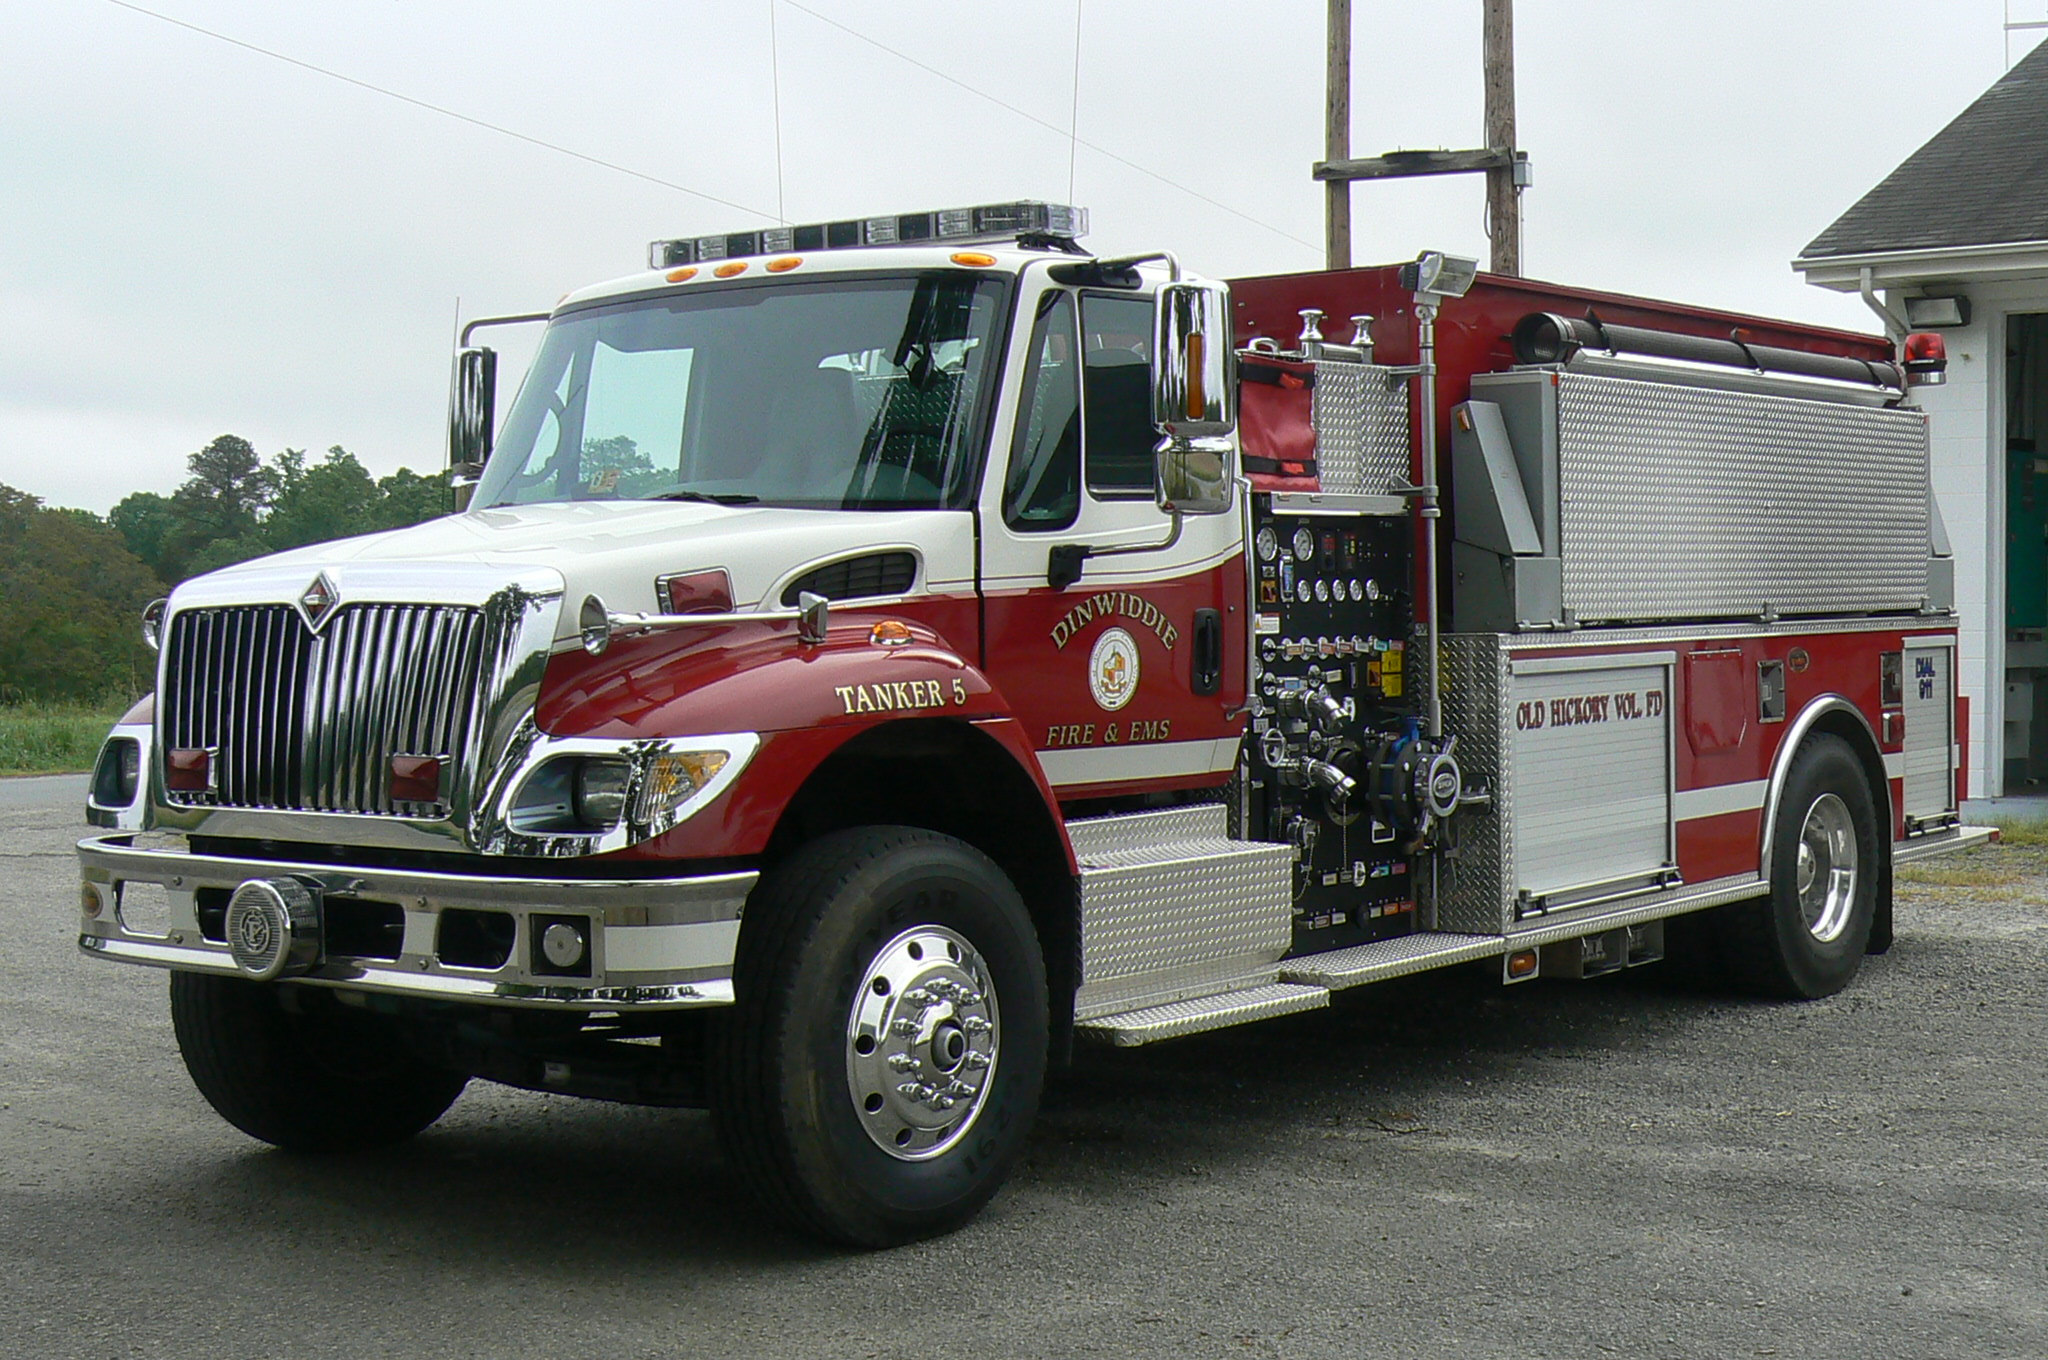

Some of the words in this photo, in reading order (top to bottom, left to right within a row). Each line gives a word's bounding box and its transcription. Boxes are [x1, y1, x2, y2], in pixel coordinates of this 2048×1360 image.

[1049, 591, 1179, 650] DINWIDDIE
[1915, 656, 1936, 679] DIAL
[834, 679, 946, 714] TANKER
[951, 677, 966, 705] 5
[1919, 678, 1933, 700] 911
[1515, 700, 1546, 731] OLD
[1550, 695, 1610, 727] HICKORY
[1614, 692, 1643, 721] VOL.
[1646, 690, 1664, 717] FD
[1045, 723, 1096, 747] FIRE
[1103, 722, 1120, 744] &
[1128, 719, 1171, 742] EMS
